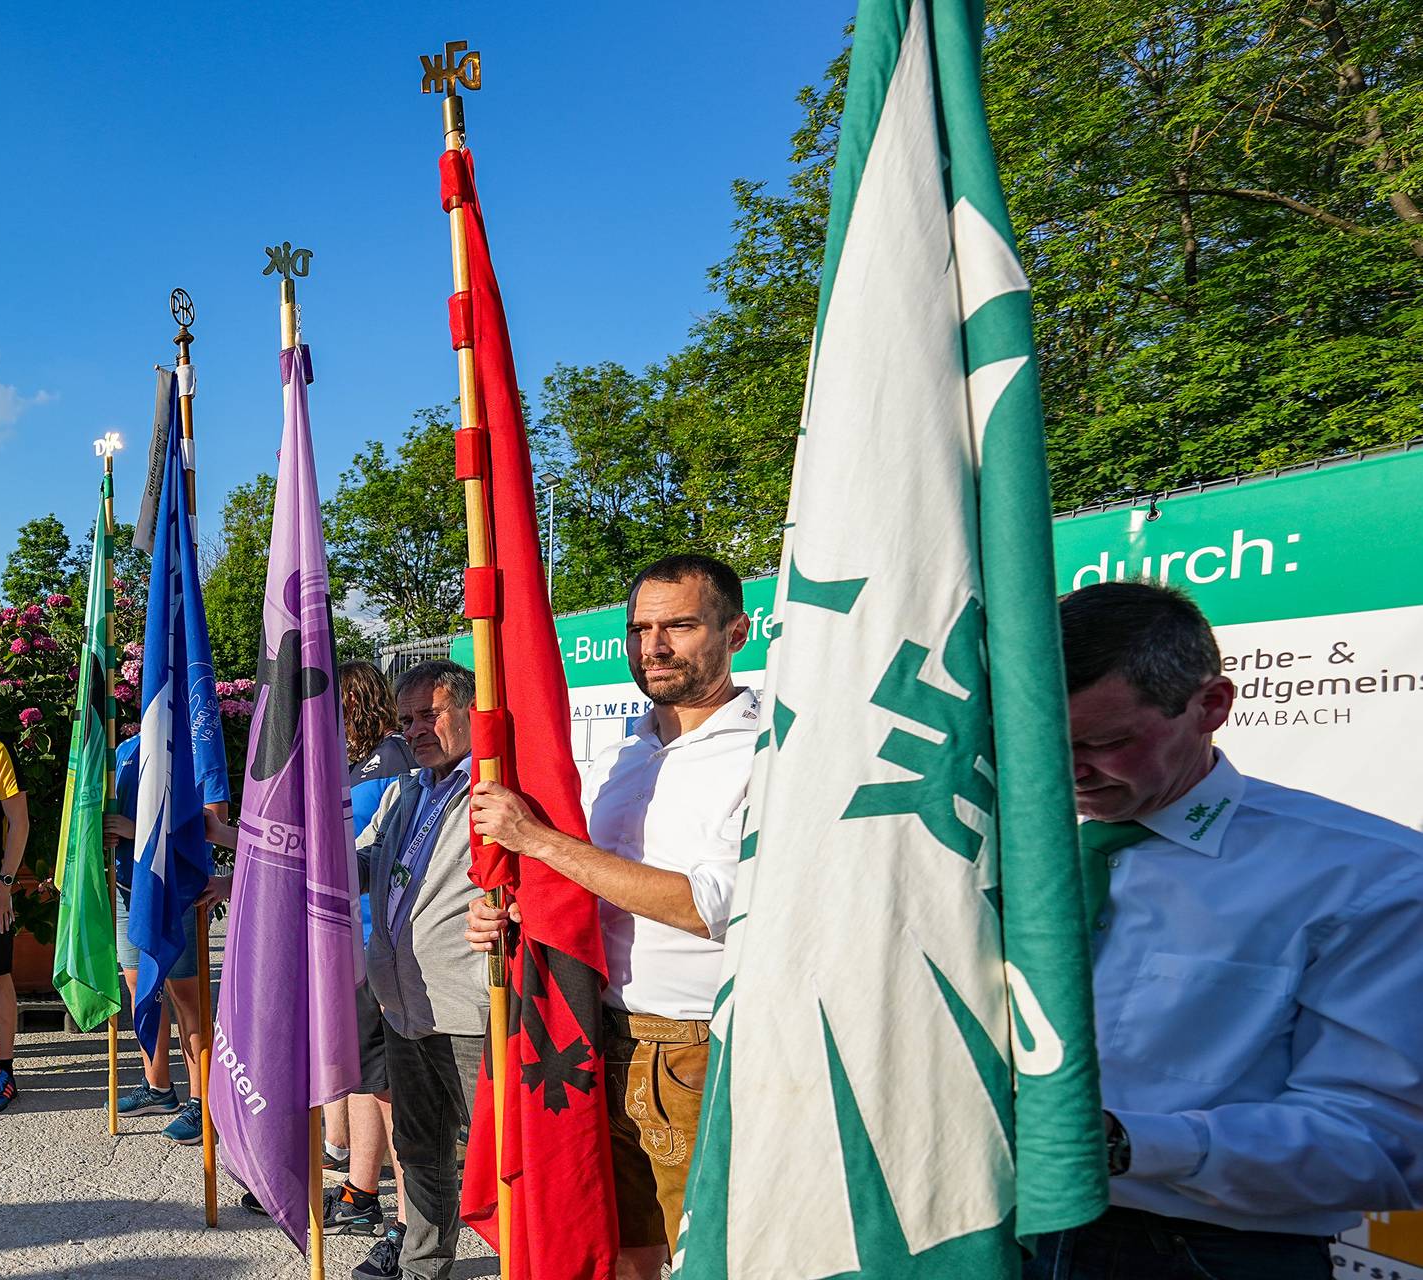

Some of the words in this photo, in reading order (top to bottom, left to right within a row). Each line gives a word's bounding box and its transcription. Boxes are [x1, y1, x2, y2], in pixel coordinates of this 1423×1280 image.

[1073, 529, 1300, 592] durch:
[1221, 649, 1312, 672] erbe-
[1328, 641, 1354, 664] &
[572, 701, 653, 717] ADTWERK
[408, 832, 426, 855] FESER
[213, 1016, 267, 1115] mpten
